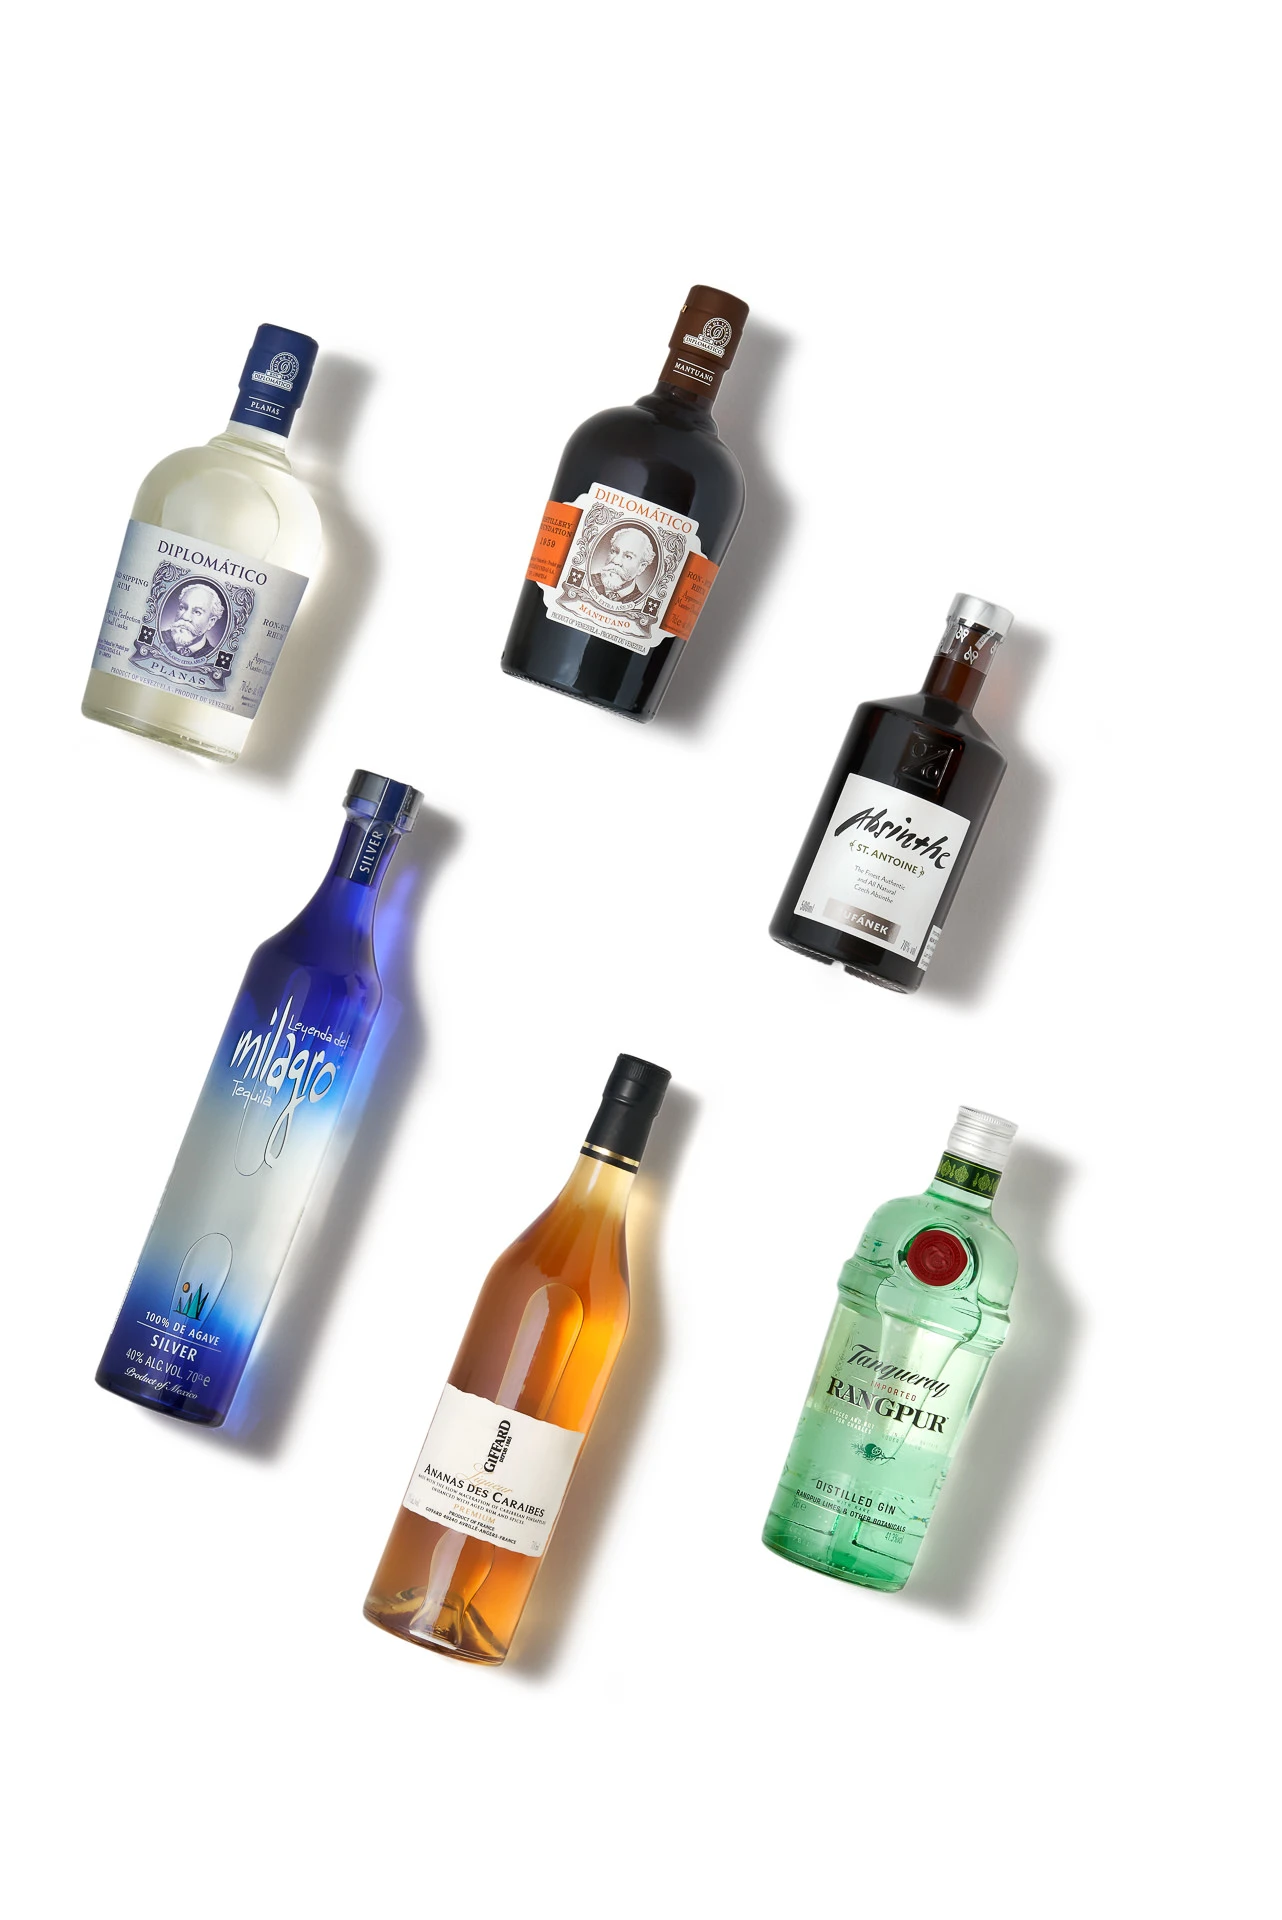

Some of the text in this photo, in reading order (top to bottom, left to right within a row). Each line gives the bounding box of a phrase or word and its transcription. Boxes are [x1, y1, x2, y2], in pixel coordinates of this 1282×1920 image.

[674, 362, 714, 382] MANTUANO
[250, 401, 280, 415] PLANAS
[595, 488, 693, 534] DIPLOMÁTICO
[157, 540, 268, 586] DIPLOMÁTICO
[117, 582, 131, 592] RUM
[121, 573, 149, 588] SIPPING
[551, 612, 570, 623] PRODUCT
[575, 620, 599, 635] VENEZUELA
[579, 603, 631, 629] MANTUANO
[110, 666, 131, 679] PRODUCT
[131, 673, 139, 681] OF
[139, 675, 171, 692] VENEZUELA
[175, 688, 198, 702] PRODUIT
[150, 661, 207, 686] PLANAS
[359, 831, 383, 874] SILVER
[834, 807, 950, 870] Absinthe
[856, 843, 918, 875] ST. ANTOINE
[854, 865, 906, 891] The Finest Authentic
[877, 883, 897, 896] Natural
[854, 883, 894, 904] Czech Absinthe
[288, 1014, 350, 1050] Leyenda del
[229, 995, 337, 1169] milagro
[231, 1079, 273, 1109] Tequila
[145, 1311, 220, 1346] 100% DE AGAVE
[125, 1348, 144, 1364] 40%
[150, 1334, 198, 1362] SILVER
[124, 1366, 198, 1400] Product of Mexico
[847, 1344, 950, 1398] Tanqueray
[826, 1376, 945, 1434] RANGPUR
[870, 1380, 917, 1402] IMPORTED
[483, 1419, 511, 1473] GIFFARD
[424, 1463, 545, 1518] ANANAS DES CARAIBES
[459, 1491, 490, 1507] MACERATION
[815, 1479, 896, 1515] DISTILLED GIN
[448, 1510, 470, 1522] PRODUCT
[477, 1521, 495, 1531] FRANCE
[453, 1503, 496, 1525] PREMIUM
[822, 1500, 840, 1512] LIMES
[842, 1507, 848, 1515] &
[849, 1509, 871, 1523] OTHER
[872, 1518, 906, 1533] BOTANICALS
